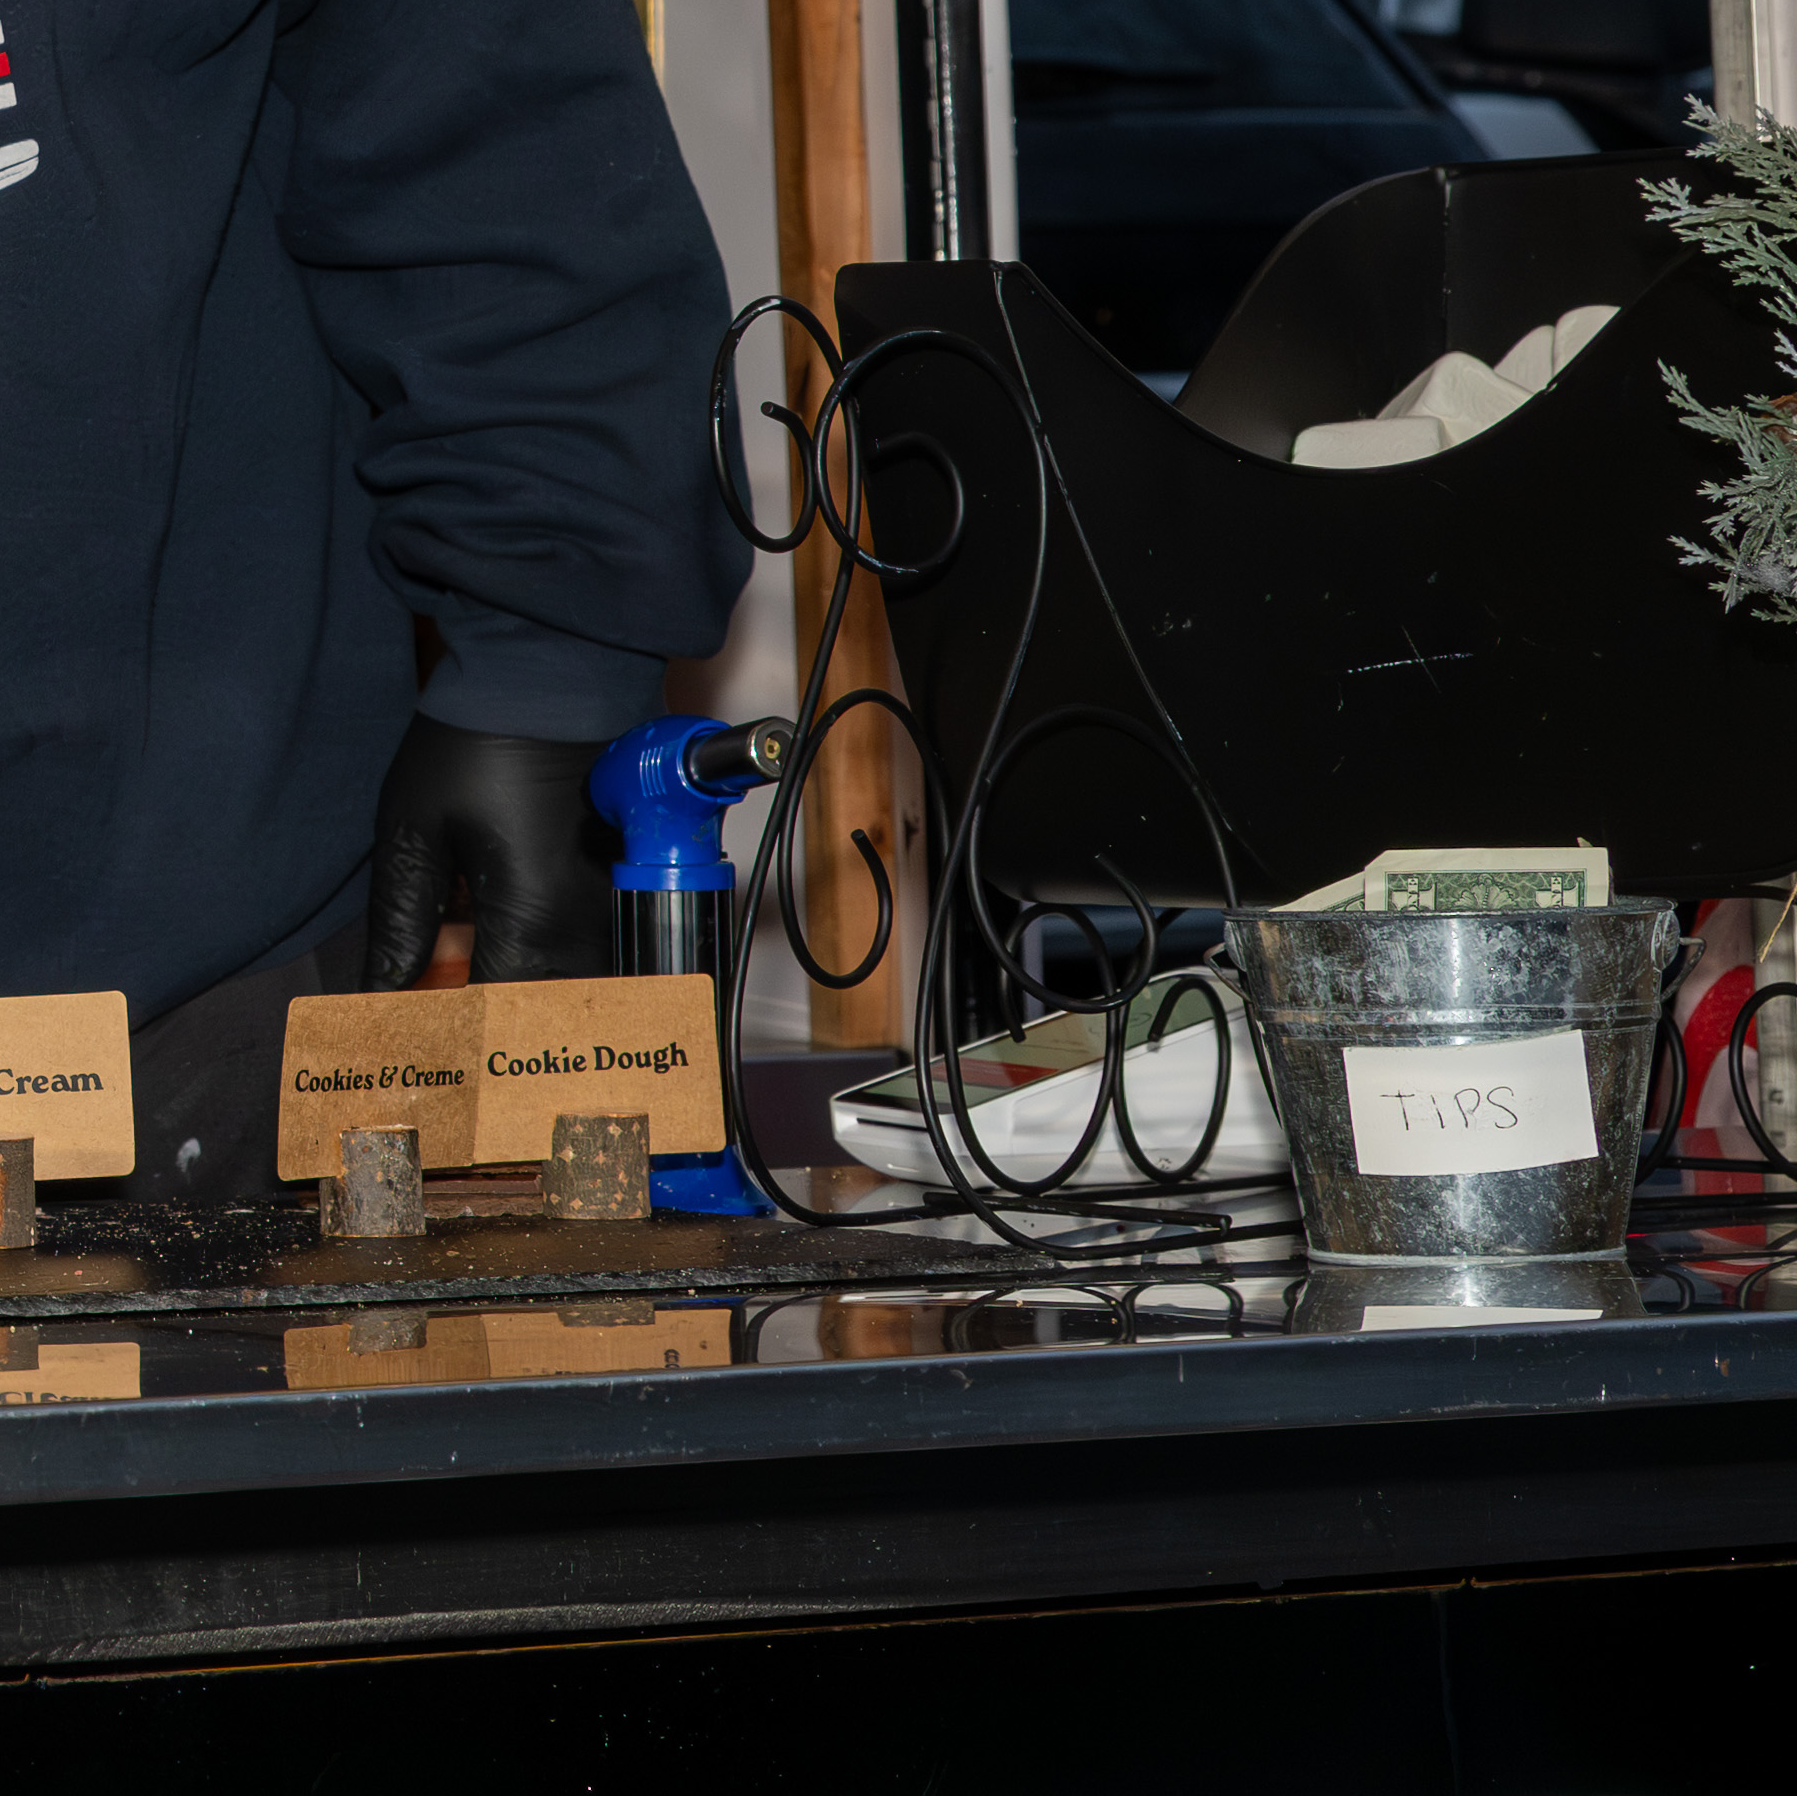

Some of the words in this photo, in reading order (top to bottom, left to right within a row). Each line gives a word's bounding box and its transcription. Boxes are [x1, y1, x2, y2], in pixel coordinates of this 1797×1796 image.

[487, 1046, 587, 1077] Cookie
[593, 1041, 689, 1075] Dough
[295, 1067, 374, 1093] Cookies
[378, 1066, 399, 1089] &
[401, 1064, 465, 1088] Creme
[1380, 1086, 1518, 1132] TIPS
